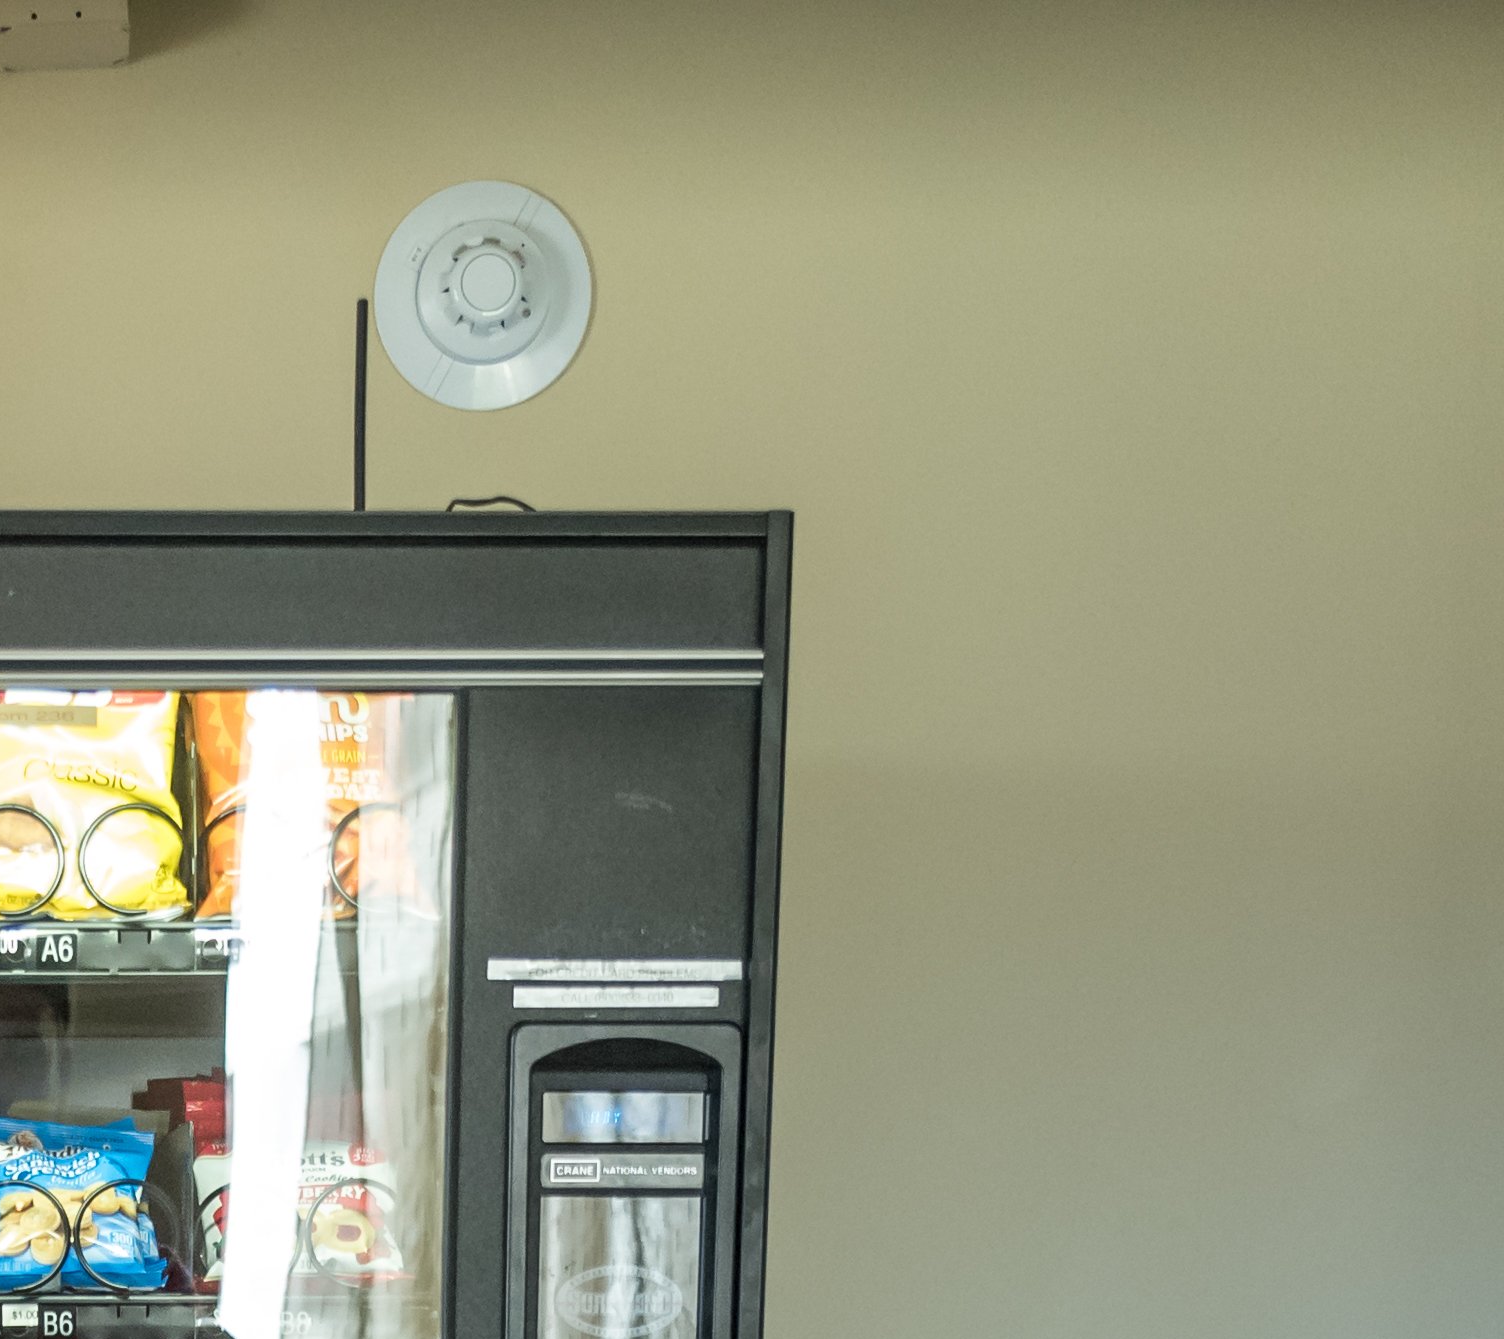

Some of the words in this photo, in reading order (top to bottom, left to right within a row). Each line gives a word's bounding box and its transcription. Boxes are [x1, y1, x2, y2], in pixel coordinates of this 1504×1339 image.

[42, 937, 74, 964] A6
[556, 1165, 595, 1177] CRANE
[602, 1165, 648, 1176] NATIONAL
[652, 1165, 698, 1177] VENDORS
[12, 1310, 38, 1321] $1.00
[44, 1311, 73, 1337] B6
